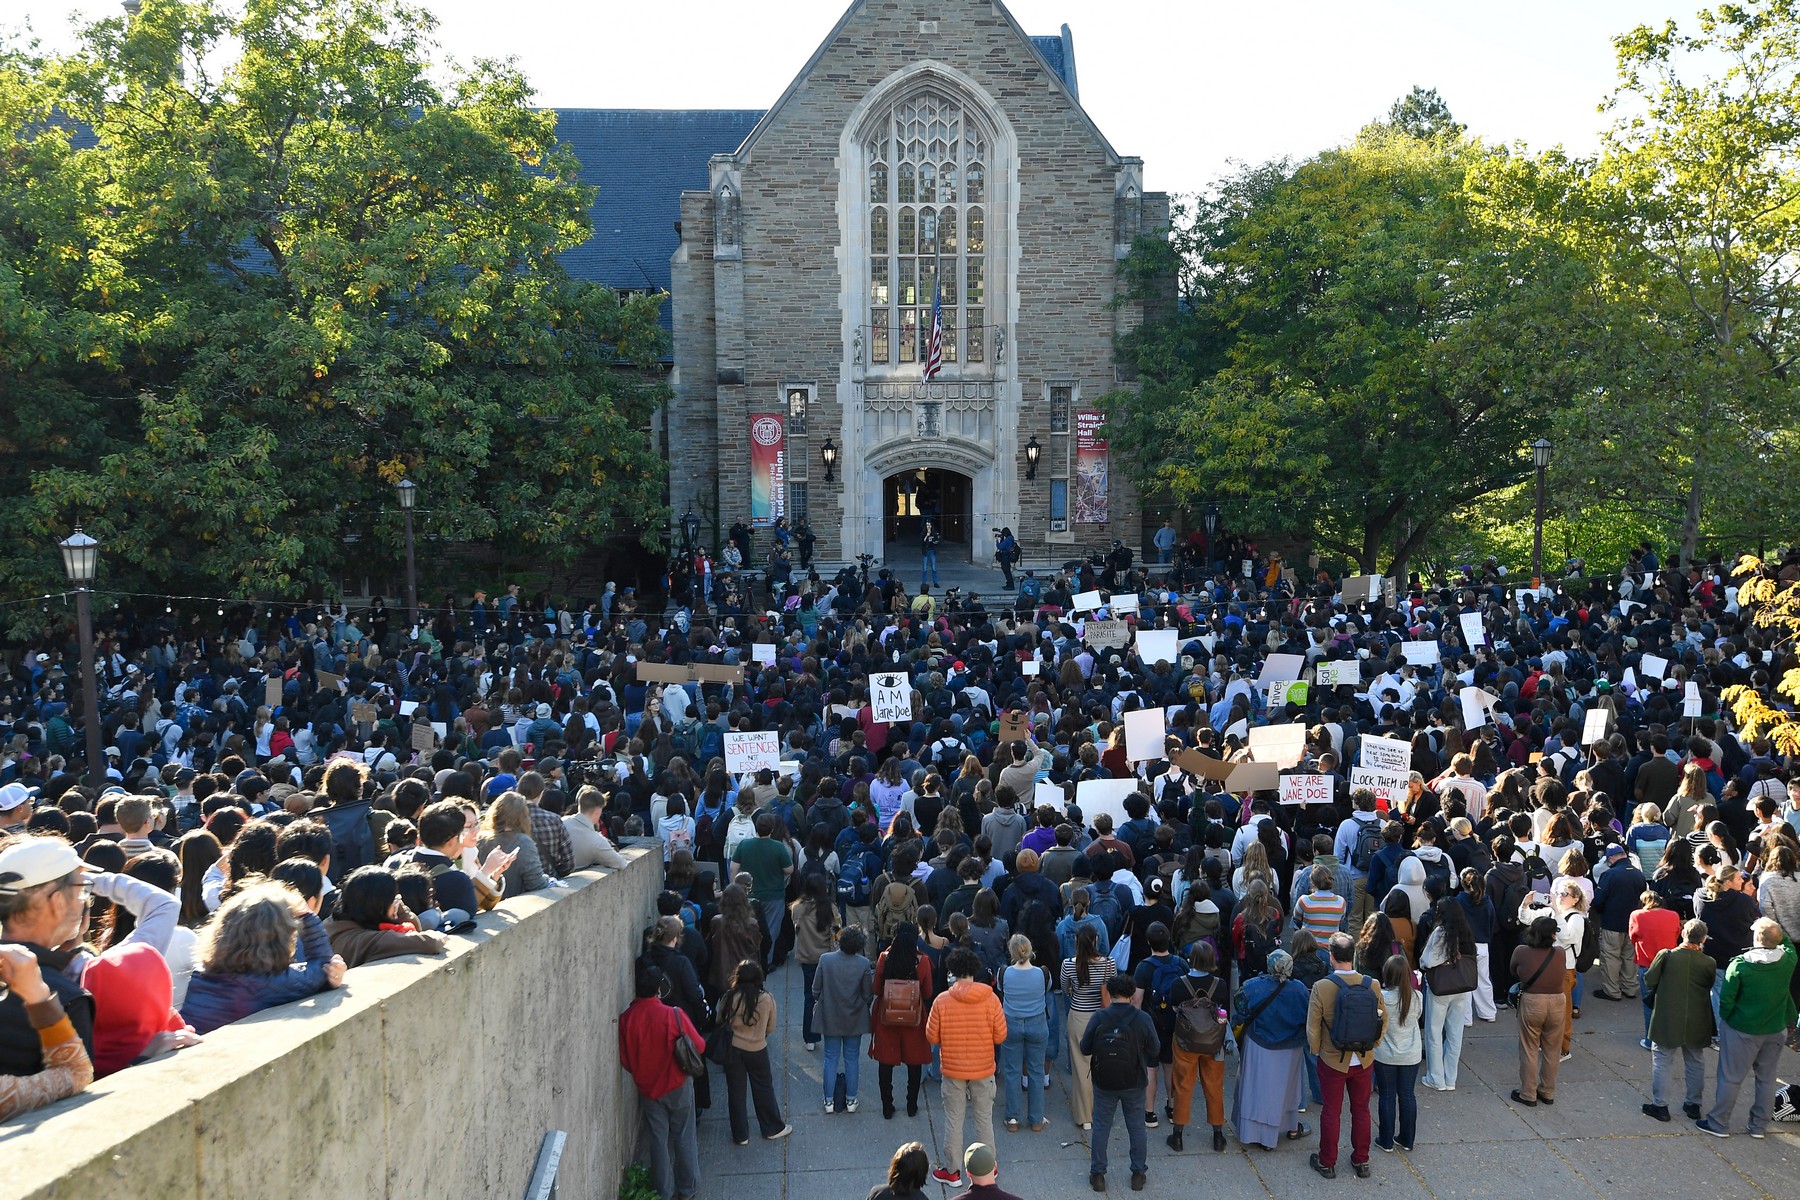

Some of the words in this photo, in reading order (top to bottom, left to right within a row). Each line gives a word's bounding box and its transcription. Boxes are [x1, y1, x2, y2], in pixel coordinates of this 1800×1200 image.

[775, 451, 784, 481] Union
[775, 482, 784, 520] tudent
[1086, 623, 1118, 631] PATRIARCHY
[878, 690, 885, 705] A
[890, 690, 904, 704] M
[874, 705, 894, 721] Jane
[895, 705, 911, 719] Doe
[748, 733, 768, 741] WANT
[727, 741, 778, 755] SENTENCES
[739, 761, 771, 771] ESSAYS
[1289, 776, 1303, 787] WE
[1305, 775, 1324, 787] ARE
[1352, 773, 1374, 786] LOCK
[1377, 775, 1397, 788] THEM
[1399, 780, 1409, 790] UP
[1282, 788, 1303, 801] JANE
[1306, 787, 1328, 799] DOE
